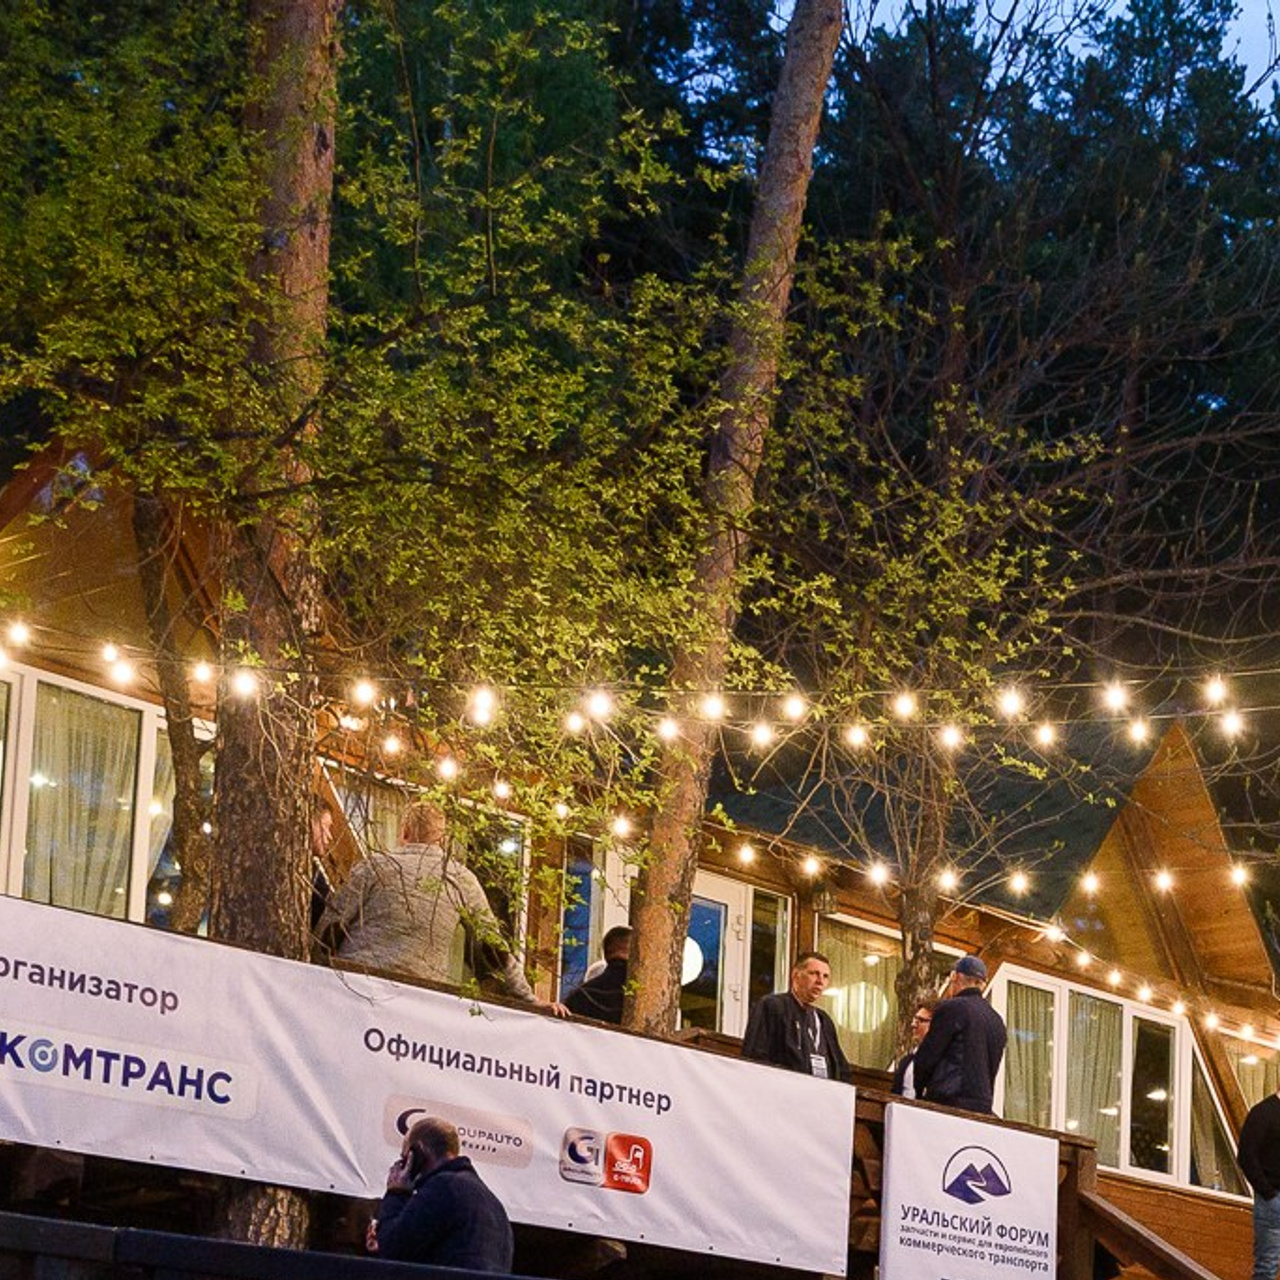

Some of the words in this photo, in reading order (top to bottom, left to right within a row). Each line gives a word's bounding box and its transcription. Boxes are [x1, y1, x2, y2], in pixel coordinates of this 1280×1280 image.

[363, 1028, 561, 1090] Официальный
[569, 1075, 673, 1115] партнер
[457, 1126, 523, 1148] OUPAUTO
[901, 1204, 993, 1237] УРАЛЬСКИЙ
[995, 1224, 1050, 1249] ФОРУМ
[899, 1236, 986, 1261] коммерческого
[988, 1252, 1049, 1273] транспорта
